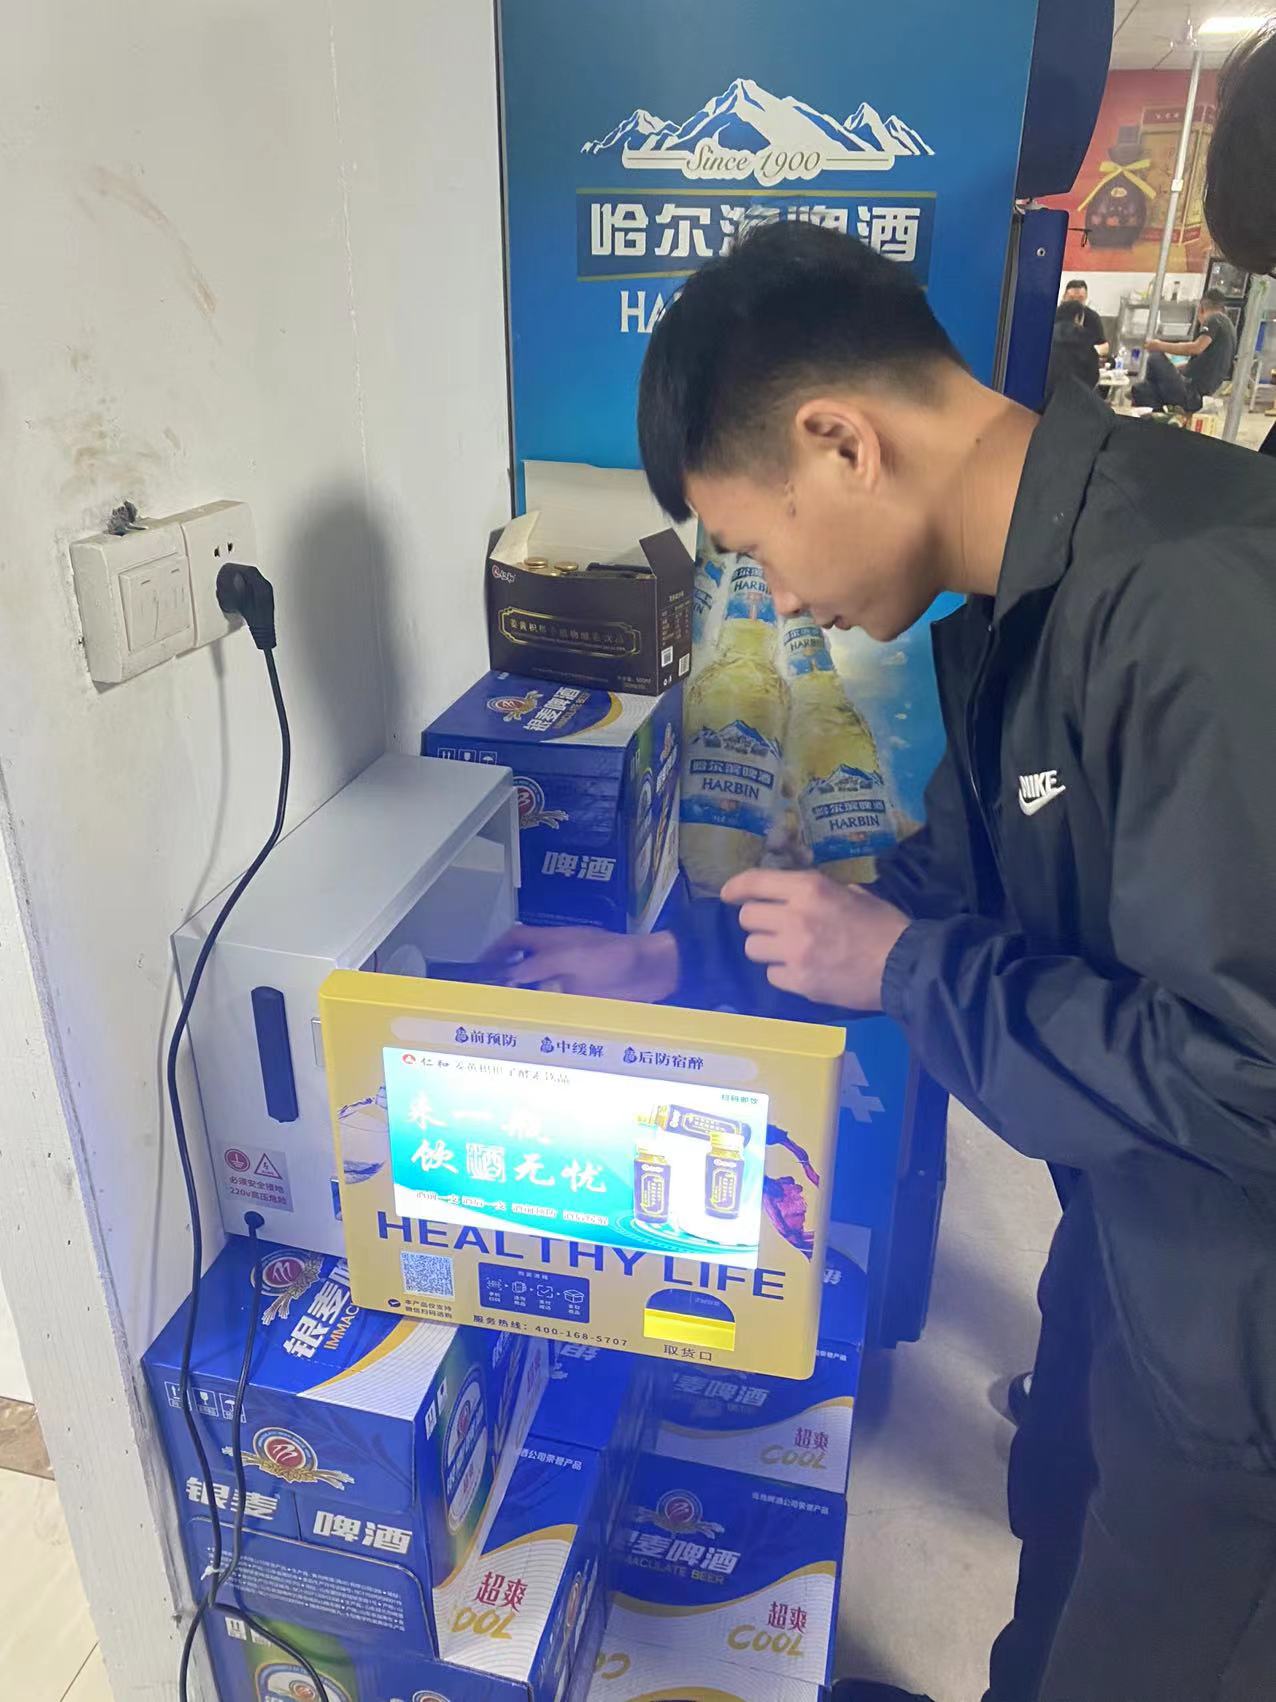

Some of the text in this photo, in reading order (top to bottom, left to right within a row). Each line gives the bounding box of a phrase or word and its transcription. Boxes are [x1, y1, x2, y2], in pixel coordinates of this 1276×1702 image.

[686, 144, 821, 178] Since 1900
[734, 580, 770, 595] HARBI
[702, 777, 760, 800] HARBIN
[1019, 769, 1057, 799] NIKE
[829, 814, 881, 831] HARBIN
[541, 850, 617, 882] 啤酒
[410, 1139, 607, 1194] 饮酒无忧
[377, 1211, 786, 1301] HEALTHY LIFE
[323, 1304, 360, 1350] IMMAC
[663, 1344, 713, 1362] 取货口
[671, 1373, 771, 1408] 麦啤酒
[793, 1427, 830, 1452] 超爽
[759, 1444, 829, 1471] COOL
[313, 1510, 413, 1554] 啤酒
[630, 1529, 742, 1575] 麦啤酒
[475, 1571, 528, 1613] 超爽
[690, 1566, 725, 1585] BEER
[766, 1601, 807, 1634] 超爽
[727, 1623, 807, 1658] COOL
